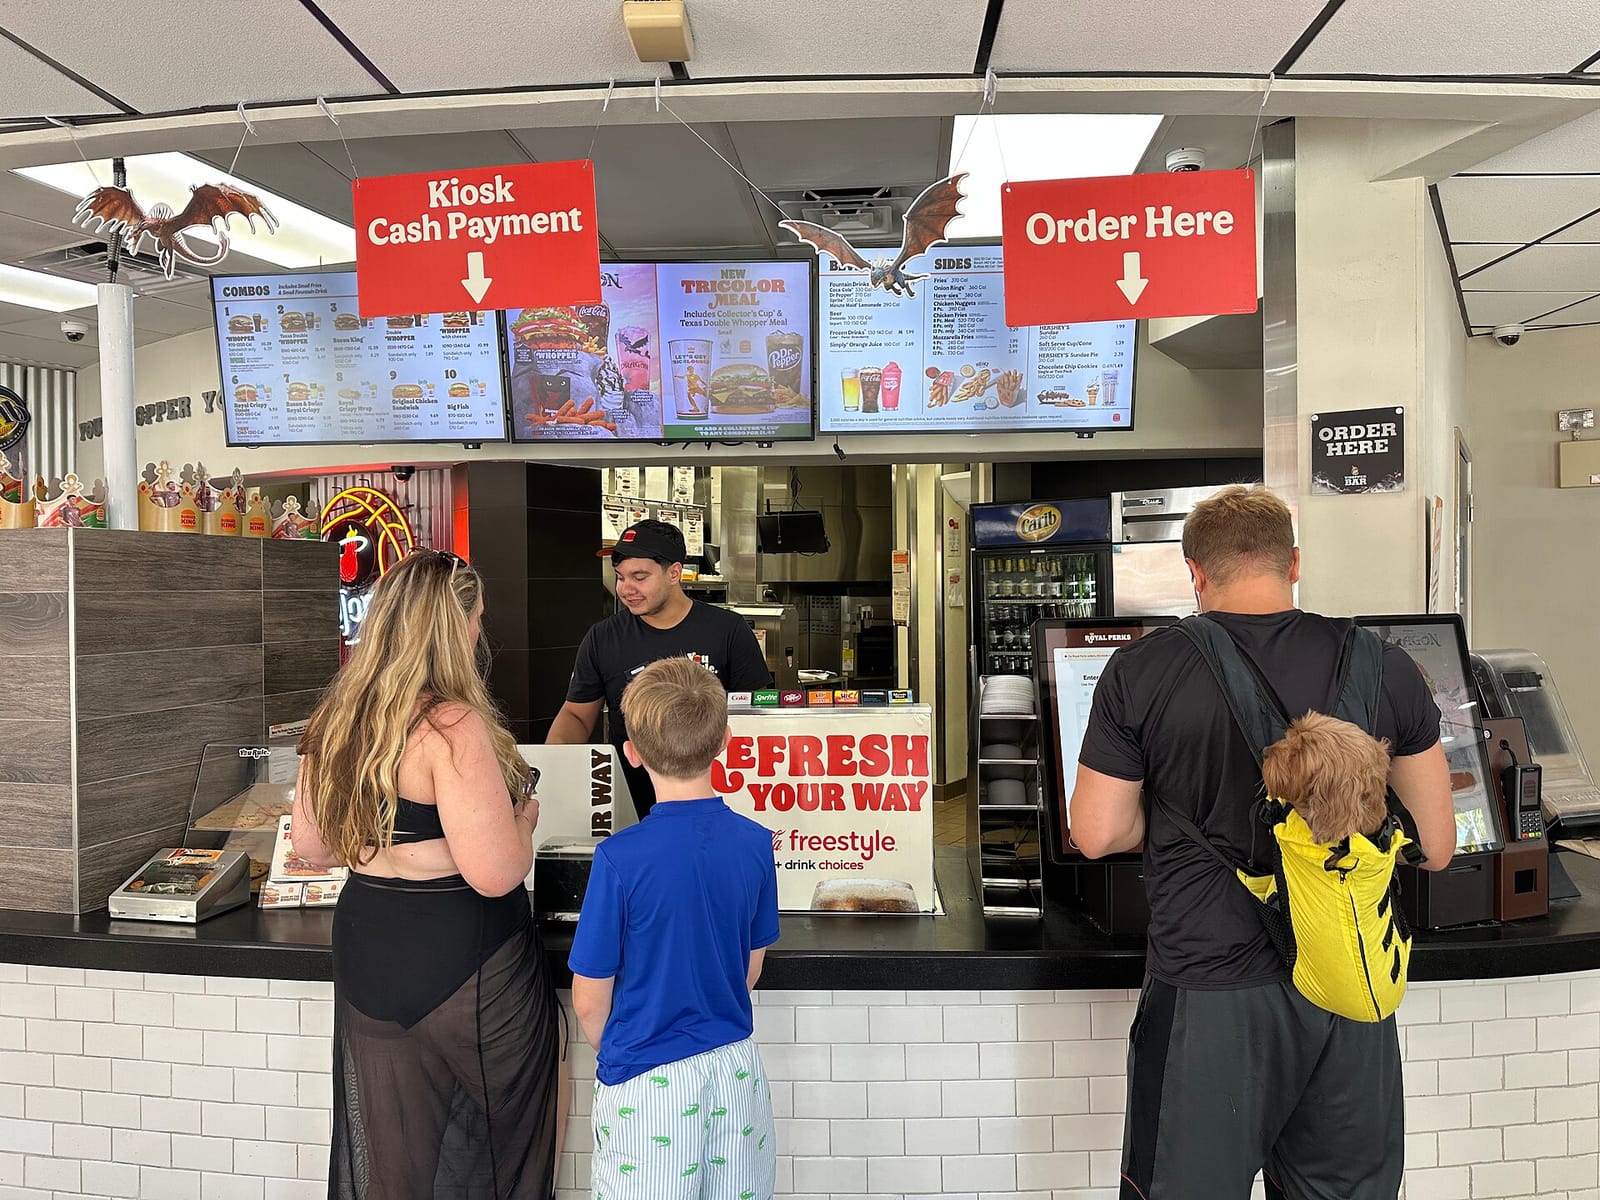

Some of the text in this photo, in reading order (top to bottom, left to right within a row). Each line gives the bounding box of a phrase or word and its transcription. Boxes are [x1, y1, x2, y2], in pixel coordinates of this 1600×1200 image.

[428, 174, 515, 208] Kiosk
[368, 207, 583, 245] Cash Payment
[1026, 205, 1234, 245] Order Here
[935, 258, 972, 270] SIDES
[720, 269, 746, 279] NEW
[223, 285, 270, 297] COMBOS
[681, 279, 785, 293] TRICOLOR
[330, 303, 338, 312] 3
[708, 293, 760, 310] MEAL
[224, 307, 230, 316] 1
[277, 305, 284, 314] 2
[580, 305, 607, 317] Coca-Cola
[684, 310, 715, 318] Includes
[680, 319, 702, 327] Texas
[703, 319, 730, 327] Double
[769, 318, 788, 326] Meal
[771, 347, 801, 369] Dr Pepper
[232, 375, 239, 384] 6
[283, 374, 290, 383] 7
[336, 372, 343, 381] 8
[390, 370, 397, 380] 9
[444, 369, 457, 379] 10
[136, 396, 192, 427] OPPER
[1318, 423, 1397, 441] ORDER
[1326, 439, 1389, 456] HERE
[1344, 478, 1367, 486] BAR
[1084, 633, 1131, 644] ROYAL PERKS
[591, 748, 612, 807] WAY
[747, 780, 929, 812] YOUR WAY
[789, 829, 897, 861] freestyle
[785, 859, 816, 871] drink
[818, 859, 864, 871] choices
